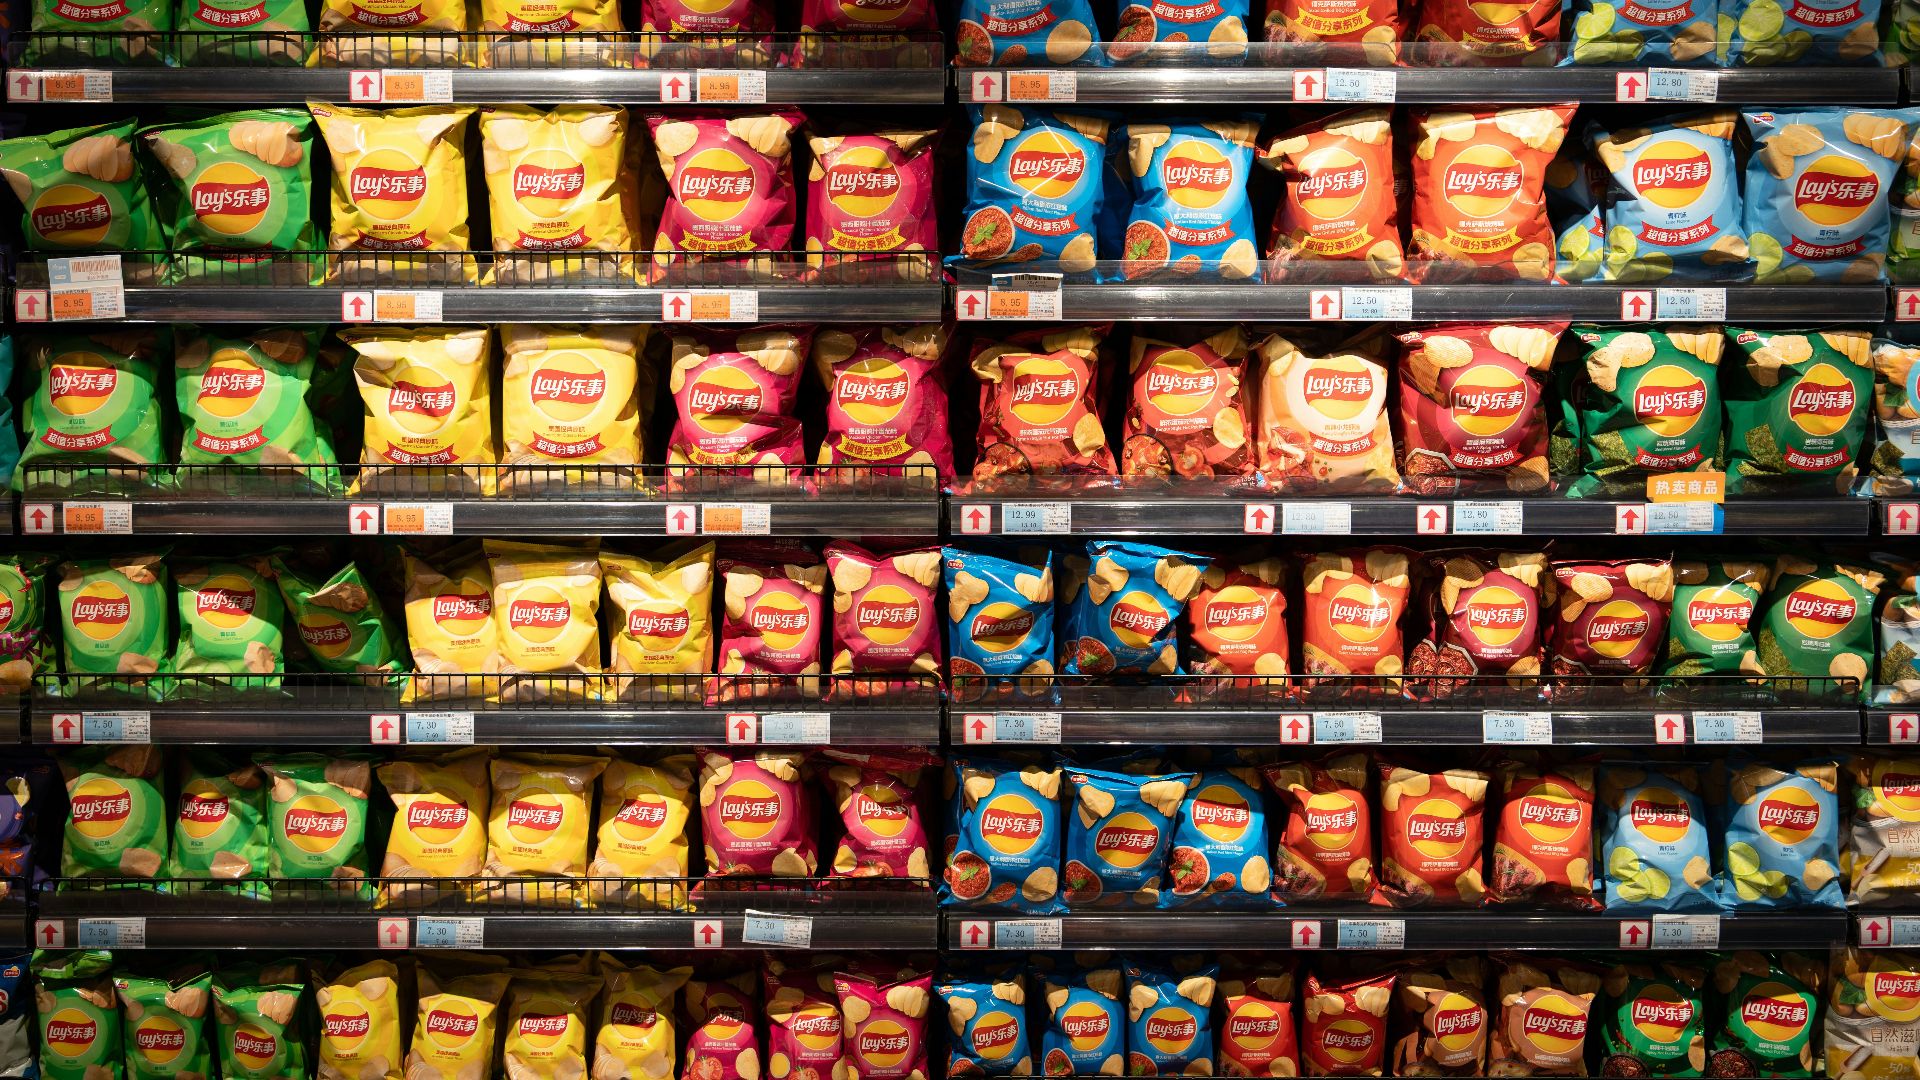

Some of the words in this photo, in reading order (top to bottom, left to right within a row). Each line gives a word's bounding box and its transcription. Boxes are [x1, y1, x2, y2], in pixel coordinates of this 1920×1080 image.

[60, 4, 119, 20] 超值分享系列
[201, 8, 261, 23] 超值分享系列
[358, 12, 419, 25] 超值分享系列
[1153, 4, 1216, 21] 超值分享系列
[1625, 8, 1687, 20] 超值分享系列
[1795, 8, 1858, 21] 超值分享系列
[987, 13, 1048, 32] 超值分享系列
[1301, 16, 1364, 32] 超值分享系列
[55, 80, 76, 88] 8.95
[1657, 78, 1682, 87] 12.80
[1012, 156, 1082, 176] Lay's乐事
[1167, 162, 1231, 183] Lay's乐事
[1637, 163, 1709, 187] Lay's乐事
[354, 171, 425, 196] Lay's乐事
[516, 167, 584, 191] Lay's乐事
[682, 174, 752, 195] Lay's乐事
[829, 170, 898, 192] Lay's乐事
[1299, 170, 1363, 194] Lay's乐事
[1447, 170, 1522, 192] Lay's乐事
[195, 186, 268, 212] Lay's乐事
[1799, 180, 1877, 202] Lay's乐事
[38, 204, 109, 232] Lay's乐事
[1013, 214, 1071, 232] 超值分享系列
[522, 236, 583, 248] 超值分享系列
[1168, 225, 1228, 242] 超值分享系列
[1304, 233, 1364, 252] 超值分享系列
[1448, 234, 1513, 250] 超值分享系列
[1645, 225, 1711, 244] 超值分享系列
[1793, 242, 1857, 257] 超值分享系列
[63, 298, 84, 309] 8.95
[1000, 298, 1021, 308] 8.95
[1352, 296, 1377, 306] 12.50
[1665, 296, 1690, 305] 12.80
[51, 374, 114, 393] Lay's乐事
[533, 377, 603, 398] Lay's乐事
[839, 381, 907, 400] Lay's乐事
[1014, 378, 1076, 400] Lay's乐事
[1149, 372, 1215, 391] Lay's乐事
[1306, 378, 1370, 394] Lay's乐事
[391, 387, 452, 408] Lay's乐事
[692, 392, 759, 411] Lay's乐事
[1454, 389, 1523, 410] Lay's乐事
[1639, 389, 1705, 410] Lay's乐事
[1793, 390, 1852, 410] Lay's乐事
[49, 434, 107, 449] 超值分享系列
[201, 436, 260, 451] 超值分享系列
[536, 439, 596, 454] 超值分享系列
[845, 443, 903, 457] 超值分享系列
[1315, 439, 1371, 453] 超值分享系列
[1454, 450, 1514, 468] 超值分享系列
[1640, 454, 1699, 468] 超值分享系列
[1789, 454, 1844, 468] 超值分享系列
[1656, 480, 1717, 496] 热卖商品
[76, 514, 96, 522] 8.95
[1010, 511, 1036, 520] 12.99
[197, 589, 255, 611] Lay's乐事
[436, 598, 489, 616] Lay's乐事
[1790, 597, 1854, 619] Lay's乐事
[74, 601, 130, 620] Lay's乐事
[512, 604, 568, 623] Lay's乐事
[860, 607, 918, 623] Lay's乐事
[1207, 601, 1264, 623] Lay's乐事
[1333, 605, 1390, 622] Lay's乐事
[1469, 606, 1525, 624] Lay's乐事
[1692, 605, 1751, 623] Lay's乐事
[631, 614, 688, 633] Lay's乐事
[754, 612, 808, 630] Lay's乐事
[1591, 619, 1648, 640] Lay's乐事
[93, 720, 112, 729] 7.50
[416, 721, 437, 730] 7.30
[1004, 719, 1024, 729] 7.30
[1324, 720, 1344, 729] 7.50
[1494, 719, 1515, 728] 7.30
[1705, 719, 1725, 728] 7.30
[72, 799, 129, 820] Lay's乐事
[410, 804, 468, 822] Lay's乐事
[510, 807, 561, 826] Lay's乐事
[722, 800, 778, 818] Lay's乐事
[1194, 804, 1249, 822] Lay's乐事
[1522, 802, 1579, 821] Lay's乐事
[1762, 807, 1817, 824] Lay's乐事
[289, 813, 346, 832] Lay's乐事
[983, 813, 1041, 833] Lay's乐事
[1308, 810, 1356, 829] Lay's乐事
[1410, 819, 1466, 838] Lay's乐事
[1099, 831, 1156, 851] Lay's乐事
[428, 927, 447, 936] 7.30
[756, 921, 774, 930] 7.30
[1006, 930, 1025, 938] 7.30
[1349, 929, 1368, 938] 7.50
[1662, 928, 1681, 937] 7.30
[1635, 1001, 1692, 1020] Lay's乐事
[1744, 999, 1805, 1022] Lay's乐事
[428, 1012, 478, 1031] Lay's乐事
[521, 1015, 567, 1032] Lay's乐事
[1064, 1018, 1108, 1036] Lay's乐事
[1149, 1021, 1196, 1036] Lay's乐事
[1232, 1017, 1279, 1034] Lay's乐事
[1436, 1010, 1481, 1033] Lay's乐事
[1526, 1010, 1585, 1033] Lay's乐事
[49, 1023, 96, 1040] Lay's乐事
[138, 1032, 184, 1047] Lay's乐事
[975, 1023, 1019, 1046] Lay's乐事
[1326, 1032, 1373, 1047] Lay's乐事
[1871, 1027, 1920, 1043] 自然滋
[236, 1038, 274, 1052] Lay's乐事
[861, 1036, 910, 1052] Lay's乐事
